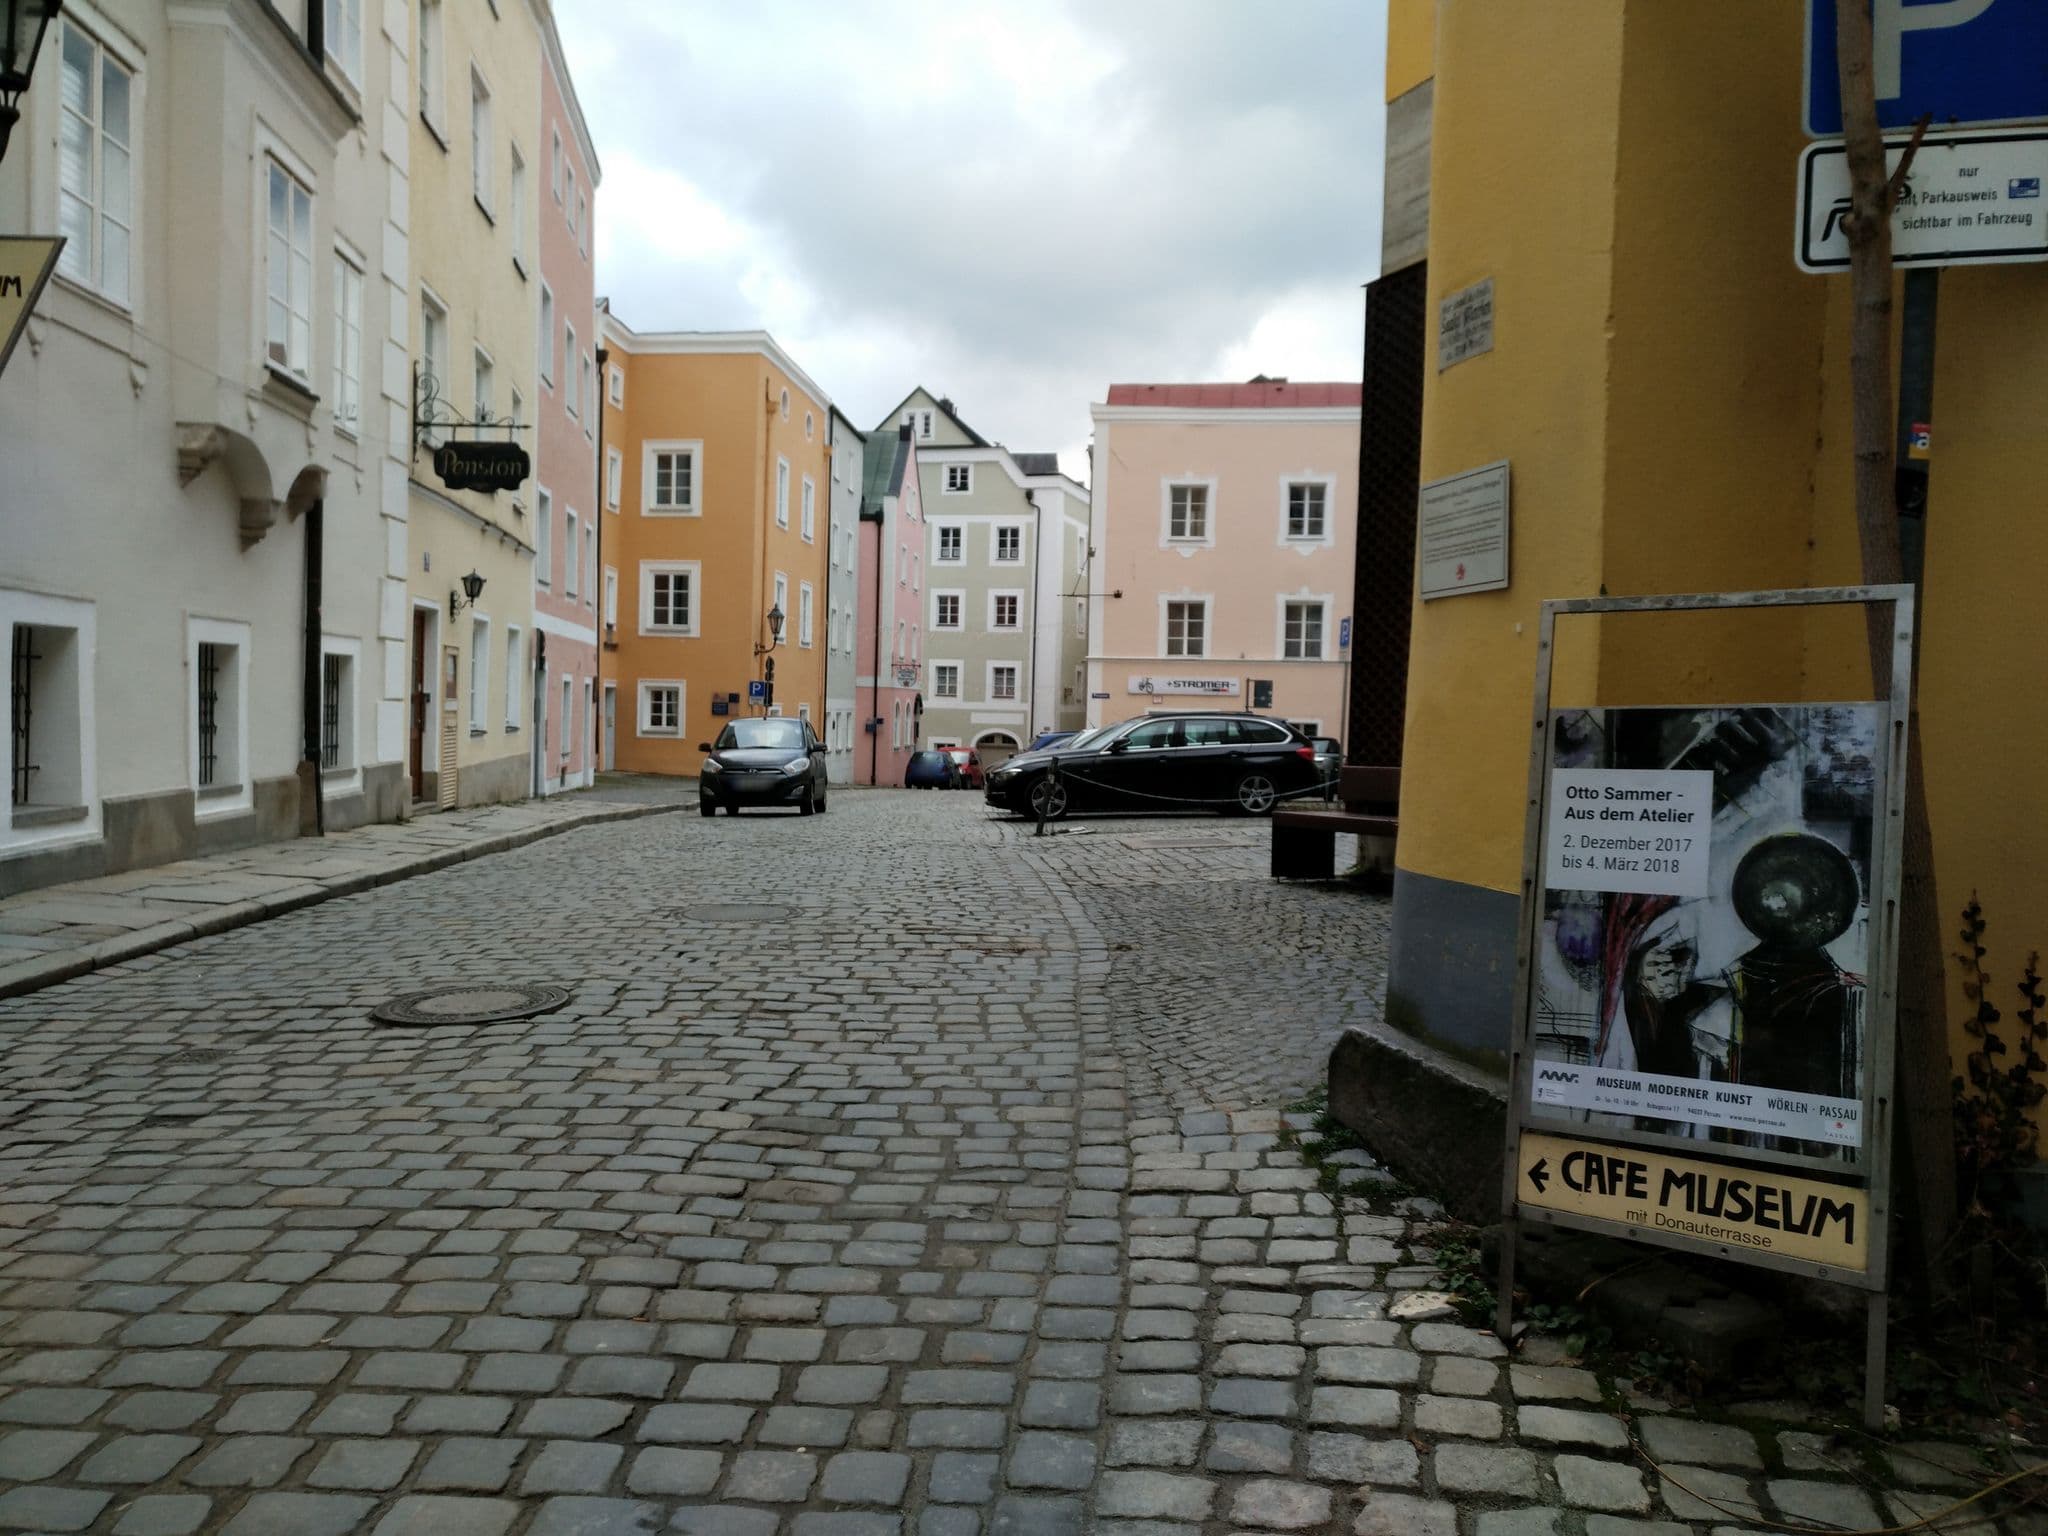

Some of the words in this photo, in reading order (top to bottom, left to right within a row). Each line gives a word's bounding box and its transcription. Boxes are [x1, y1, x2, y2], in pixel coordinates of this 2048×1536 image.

[1958, 166, 1980, 178] nur
[1922, 189, 1998, 205] Parkausweis
[1903, 214, 1952, 230] sichtbar
[1957, 213, 1972, 227] im
[1978, 212, 2033, 226] Fahrzeug
[440, 448, 522, 477] Pension
[752, 682, 761, 695] P
[1566, 785, 1600, 800] Otto
[1604, 786, 1673, 801] Sammer
[1564, 806, 1595, 821] Aus
[1600, 807, 1634, 821] dem
[1639, 808, 1694, 823] Atelier
[1563, 834, 1575, 848] 2.
[1580, 835, 1651, 851] Dezember
[1655, 837, 1692, 852] 2017
[1562, 854, 1582, 869] bis
[1586, 856, 1599, 870] 4.
[1604, 856, 1639, 871] März
[1644, 858, 1679, 873] 2018
[1596, 1076, 1642, 1092] MUSEUM
[1648, 1083, 1709, 1101] MODERNER
[1716, 1091, 1753, 1106] KUNST
[1767, 1097, 1808, 1114] WÖRLEN
[1819, 1105, 1857, 1121] PASSAU
[1561, 1150, 1648, 1200] CAFE
[1658, 1167, 1855, 1245] MUSEUM
[1626, 1209, 1648, 1223] mit
[1655, 1212, 1772, 1248] Donauterrasse
